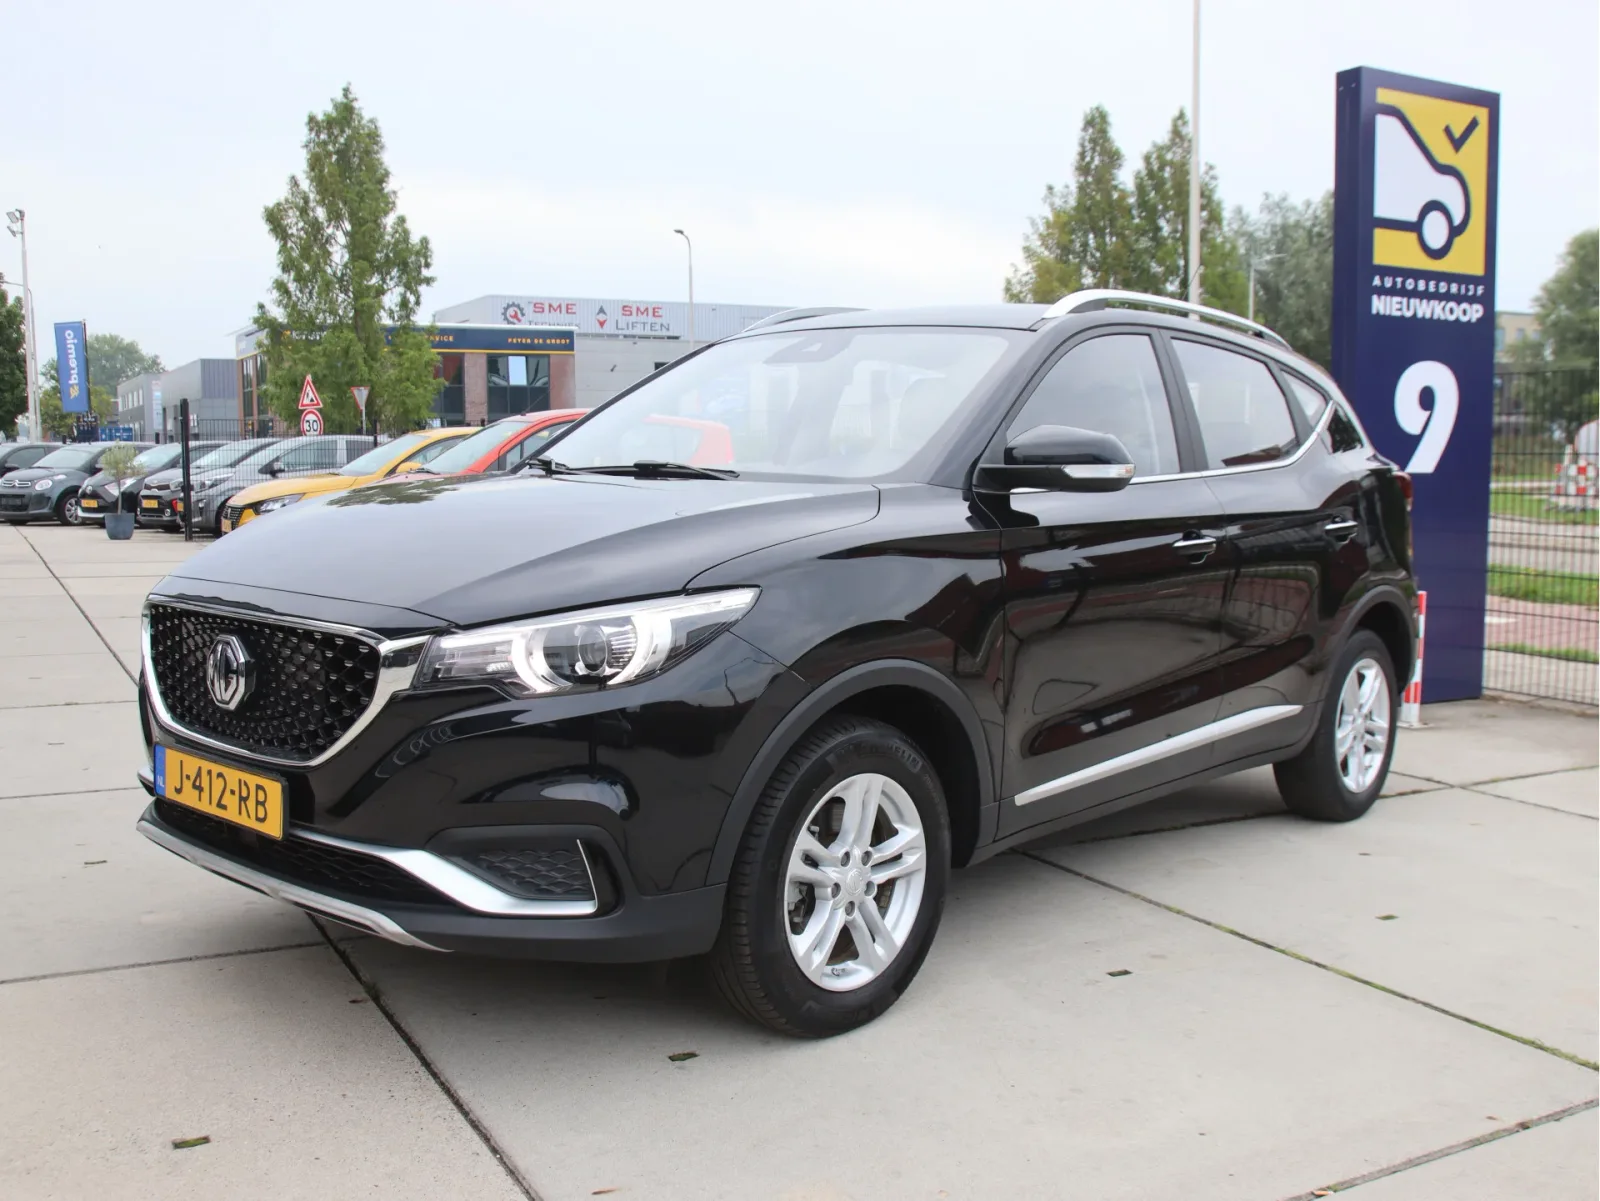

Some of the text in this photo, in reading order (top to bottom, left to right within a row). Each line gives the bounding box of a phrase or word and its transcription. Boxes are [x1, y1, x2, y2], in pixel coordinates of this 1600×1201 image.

[1372, 275, 1486, 296] AUTOBEDRIJF
[533, 302, 577, 315] SME
[621, 305, 663, 318] SME
[1371, 294, 1485, 323] NIEUWKOOP
[615, 318, 670, 332] LIFTEN
[1393, 360, 1460, 474] 9
[305, 420, 319, 432] 30
[157, 775, 165, 787] NL
[174, 759, 268, 823] J-412-RB
